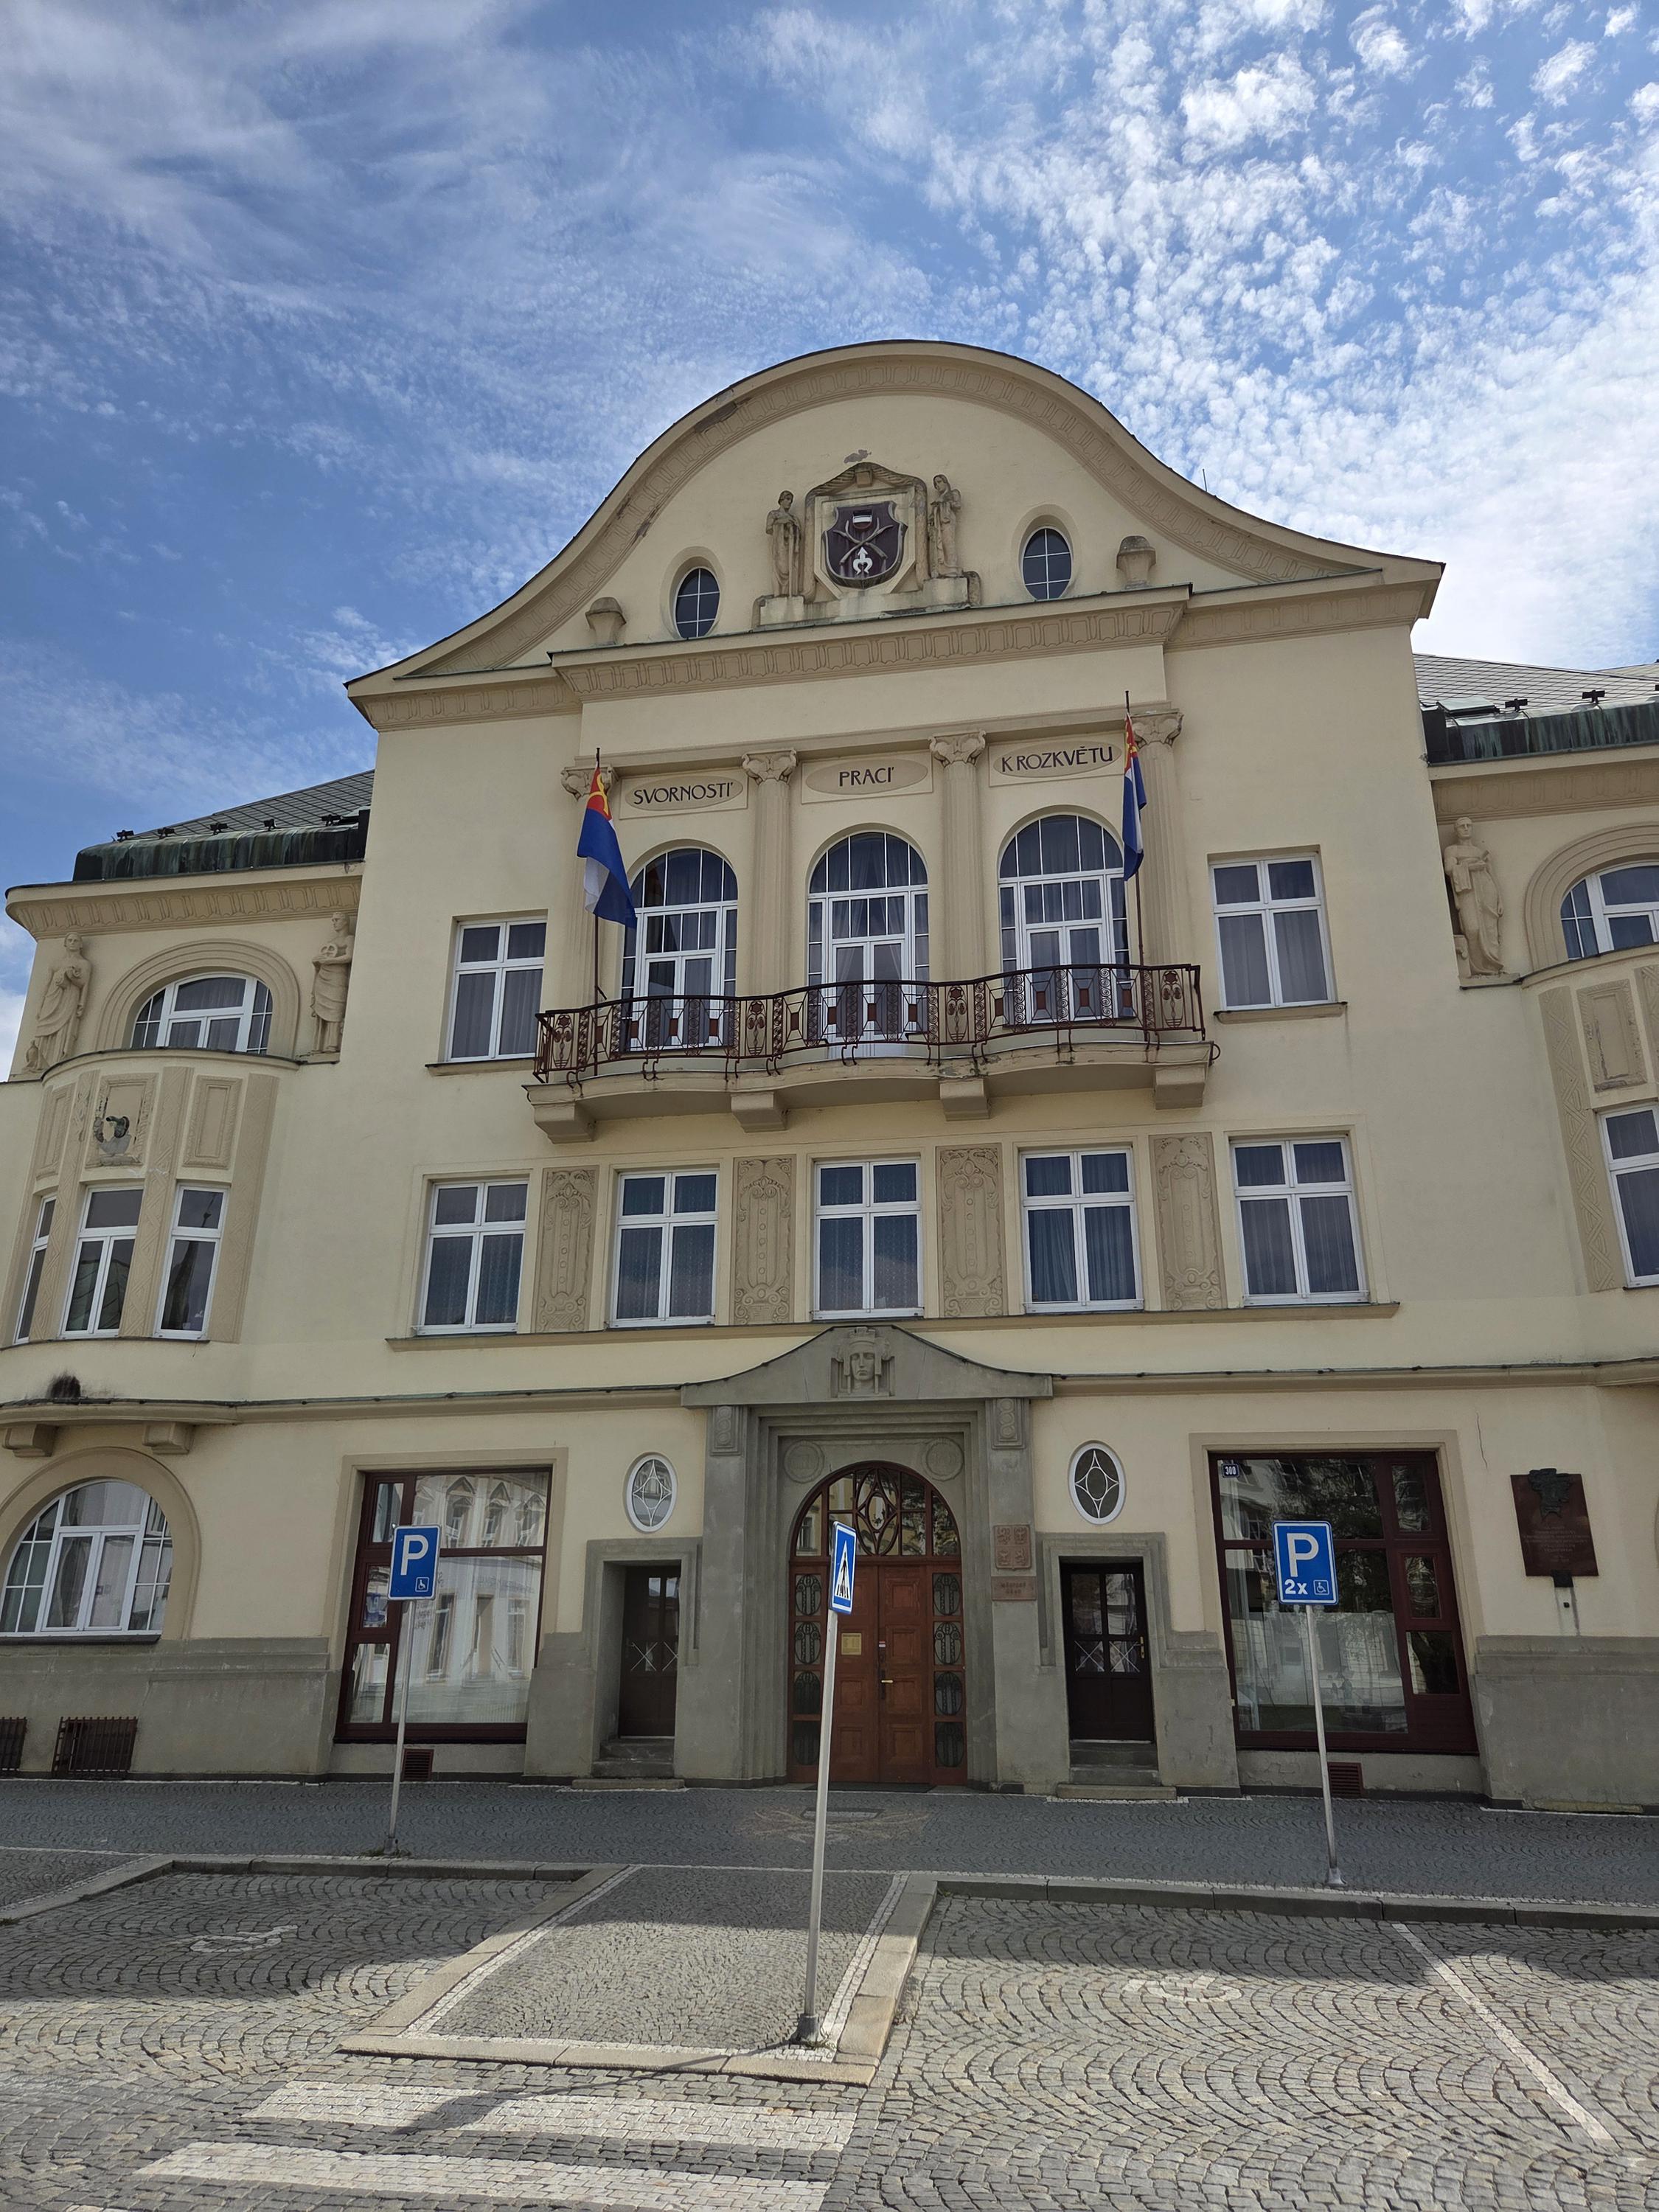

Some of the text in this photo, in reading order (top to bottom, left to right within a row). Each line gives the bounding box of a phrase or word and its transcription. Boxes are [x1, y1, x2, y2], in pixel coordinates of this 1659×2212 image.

[1001, 745, 1113, 773] K ROZKVĚTU
[838, 766, 895, 787] PRACÍ
[633, 782, 734, 805] SVORNOSTÍ
[1225, 1466, 1237, 1475] 300
[400, 1534, 428, 1576] P
[1287, 1533, 1319, 1577] P
[1284, 1579, 1308, 1595] 2x
